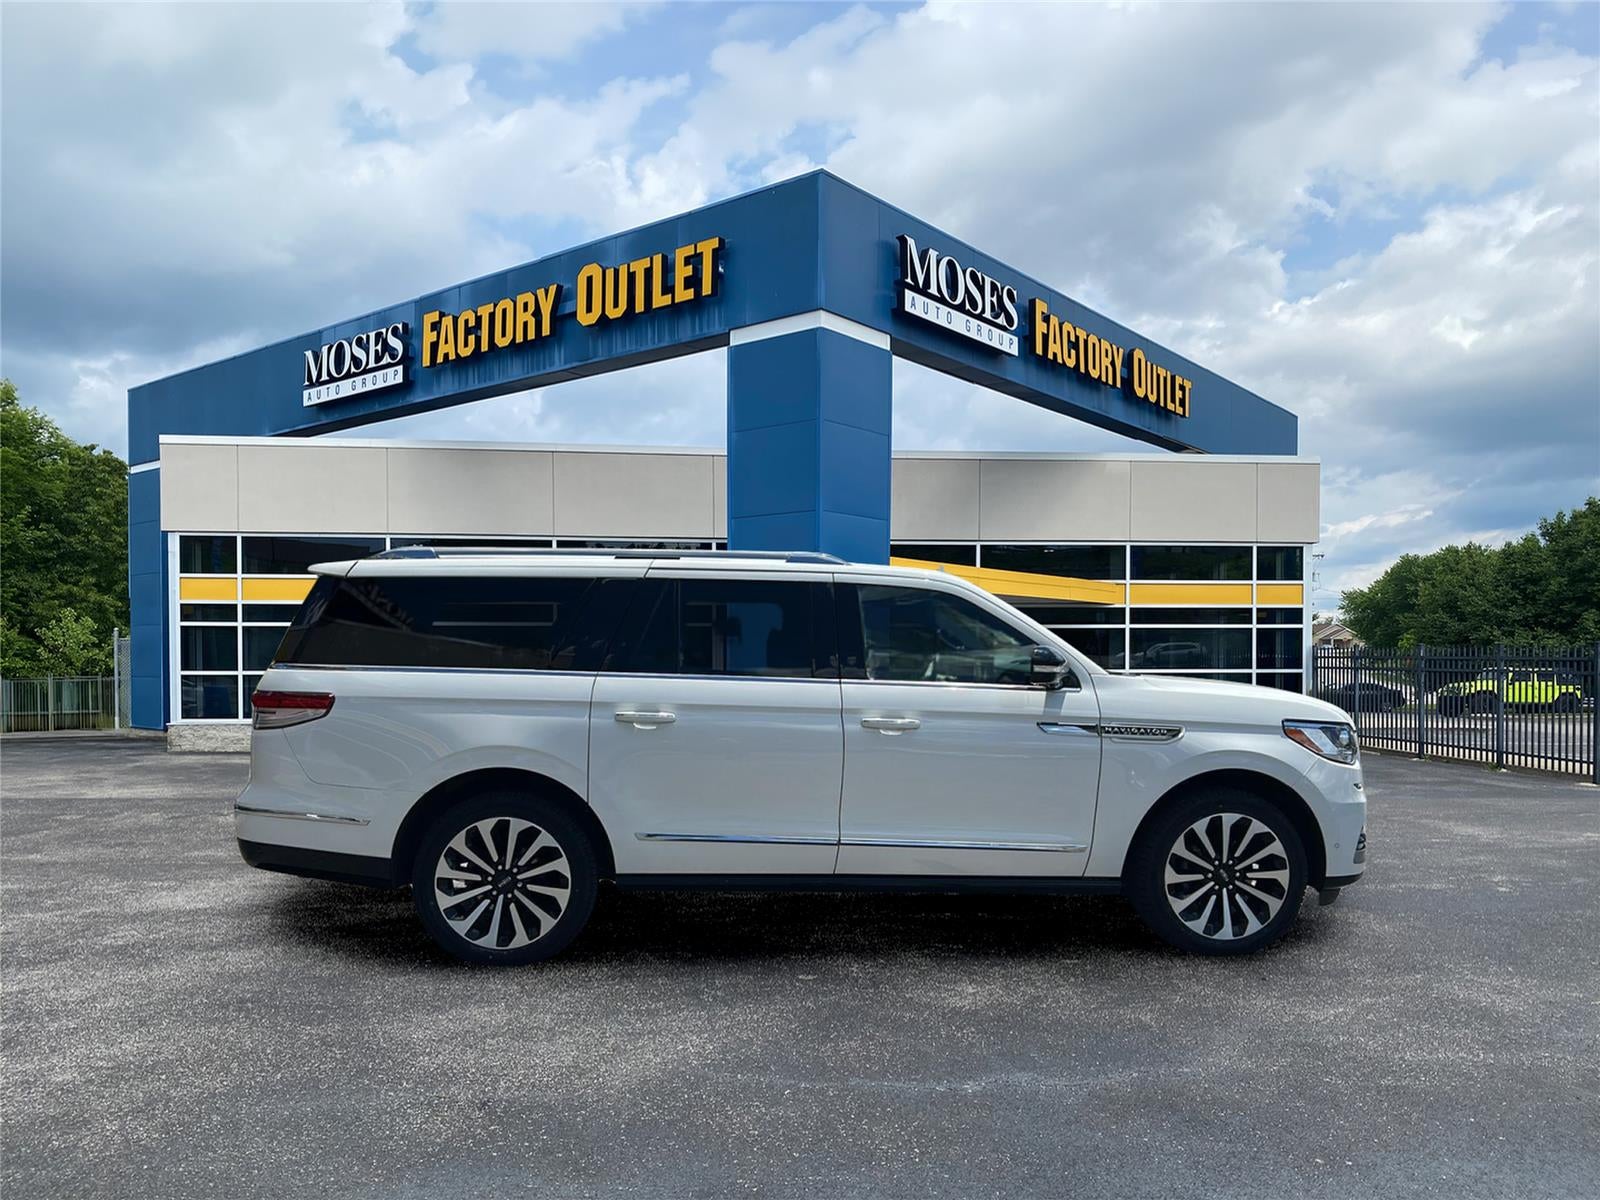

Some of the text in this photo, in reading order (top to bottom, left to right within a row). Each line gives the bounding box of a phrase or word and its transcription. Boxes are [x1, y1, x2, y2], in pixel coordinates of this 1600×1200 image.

[422, 237, 720, 368] FACTORY OUTLET
[904, 234, 1018, 331] MOSES
[910, 295, 1014, 350] AUTO GROUP
[303, 323, 404, 386] MOSES
[307, 369, 399, 402] AUTO GROUP
[1035, 298, 1192, 418] FACTORY OUTLET
[1104, 726, 1168, 735] NAVIGATOR
